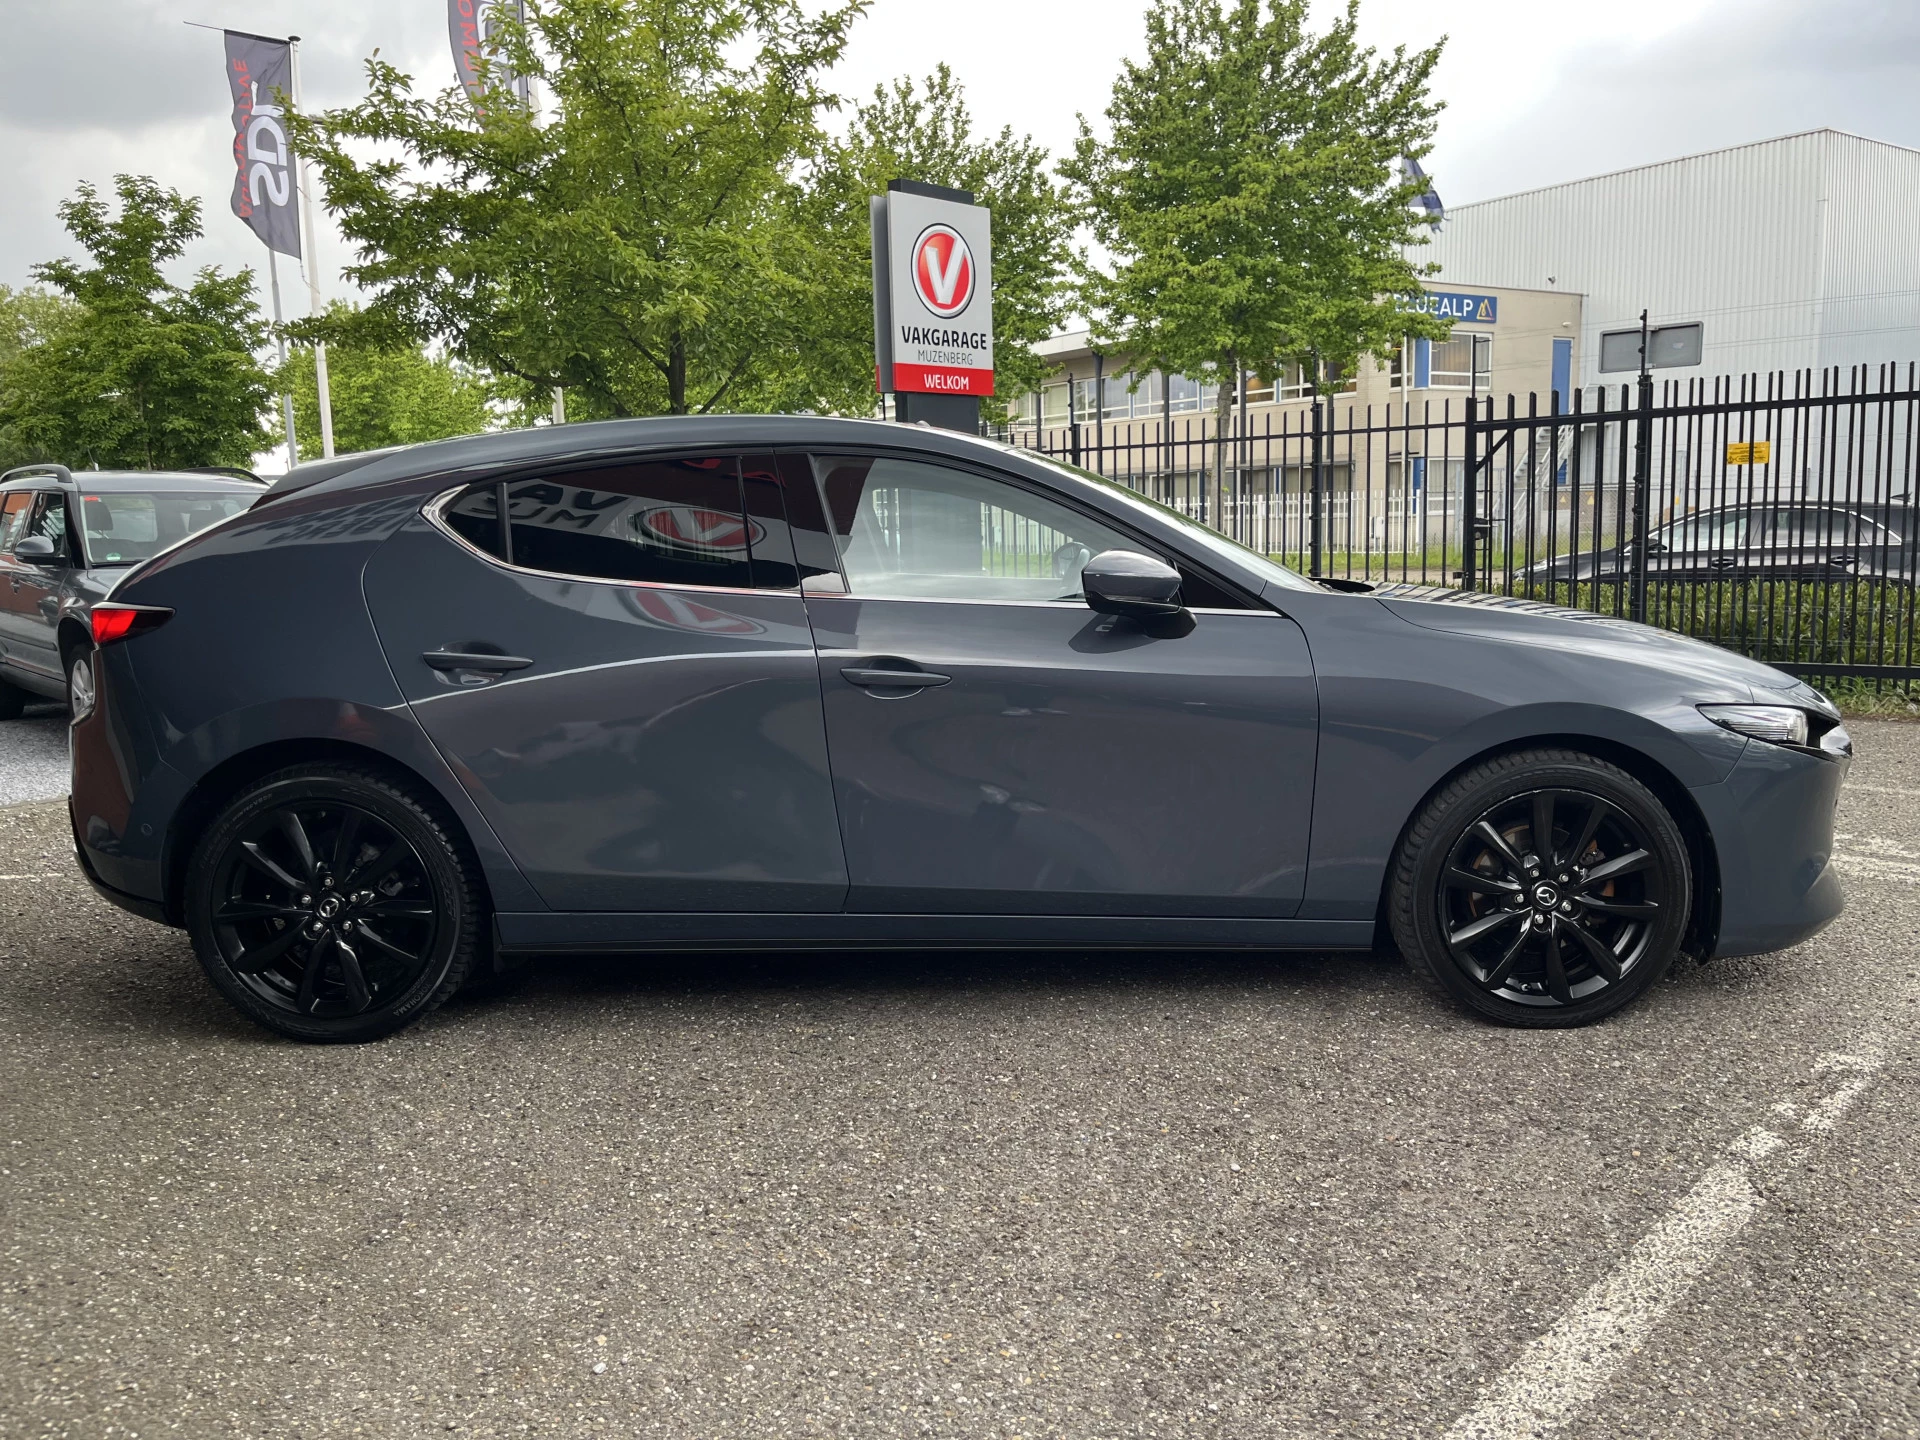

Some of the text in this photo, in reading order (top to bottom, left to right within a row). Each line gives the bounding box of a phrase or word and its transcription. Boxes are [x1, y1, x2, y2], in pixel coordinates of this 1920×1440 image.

[901, 325, 987, 350] VAKGARAGE
[917, 349, 973, 366] MUZENBERG
[923, 373, 970, 391] WELKOM
[392, 982, 433, 1017] YOKOHAMA
